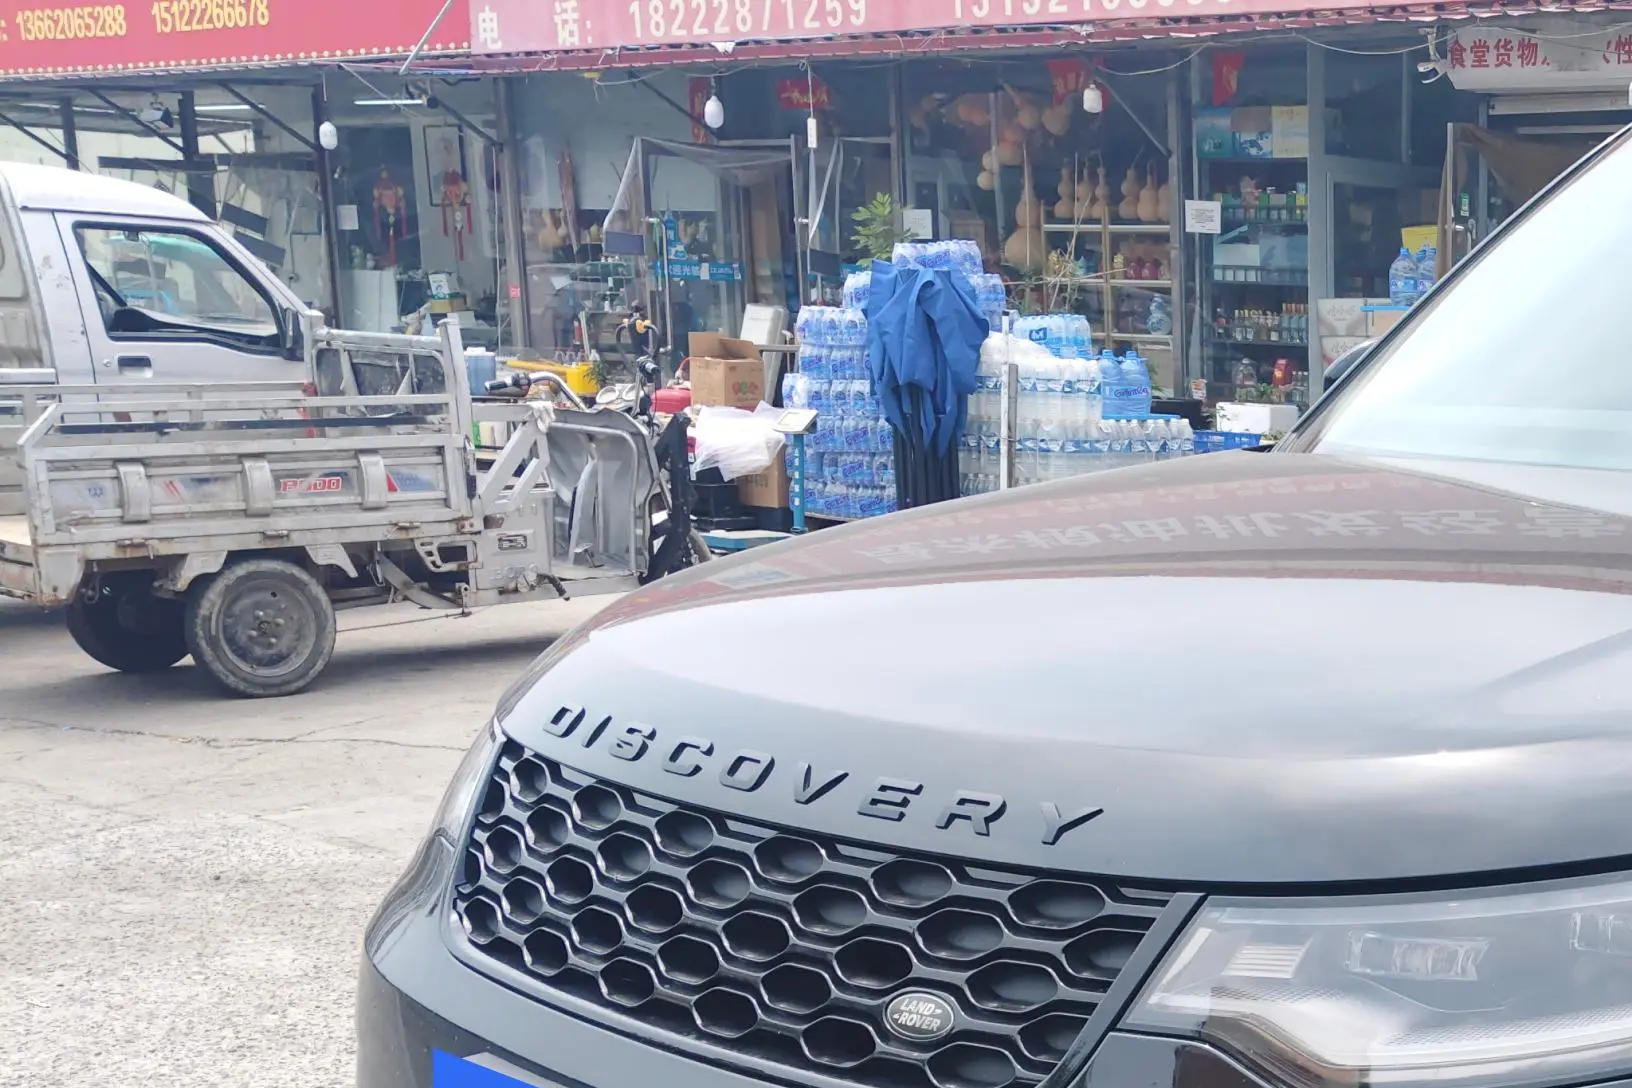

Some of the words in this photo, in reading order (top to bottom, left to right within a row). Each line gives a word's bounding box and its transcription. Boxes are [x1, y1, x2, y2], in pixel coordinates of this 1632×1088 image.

[16, 5, 127, 41] 13662065288
[152, 0, 270, 33] 15122266678
[1448, 37, 1550, 68] 食堂货物
[542, 703, 1105, 846] DISCOVERY
[898, 1011, 942, 1032] ROVER
